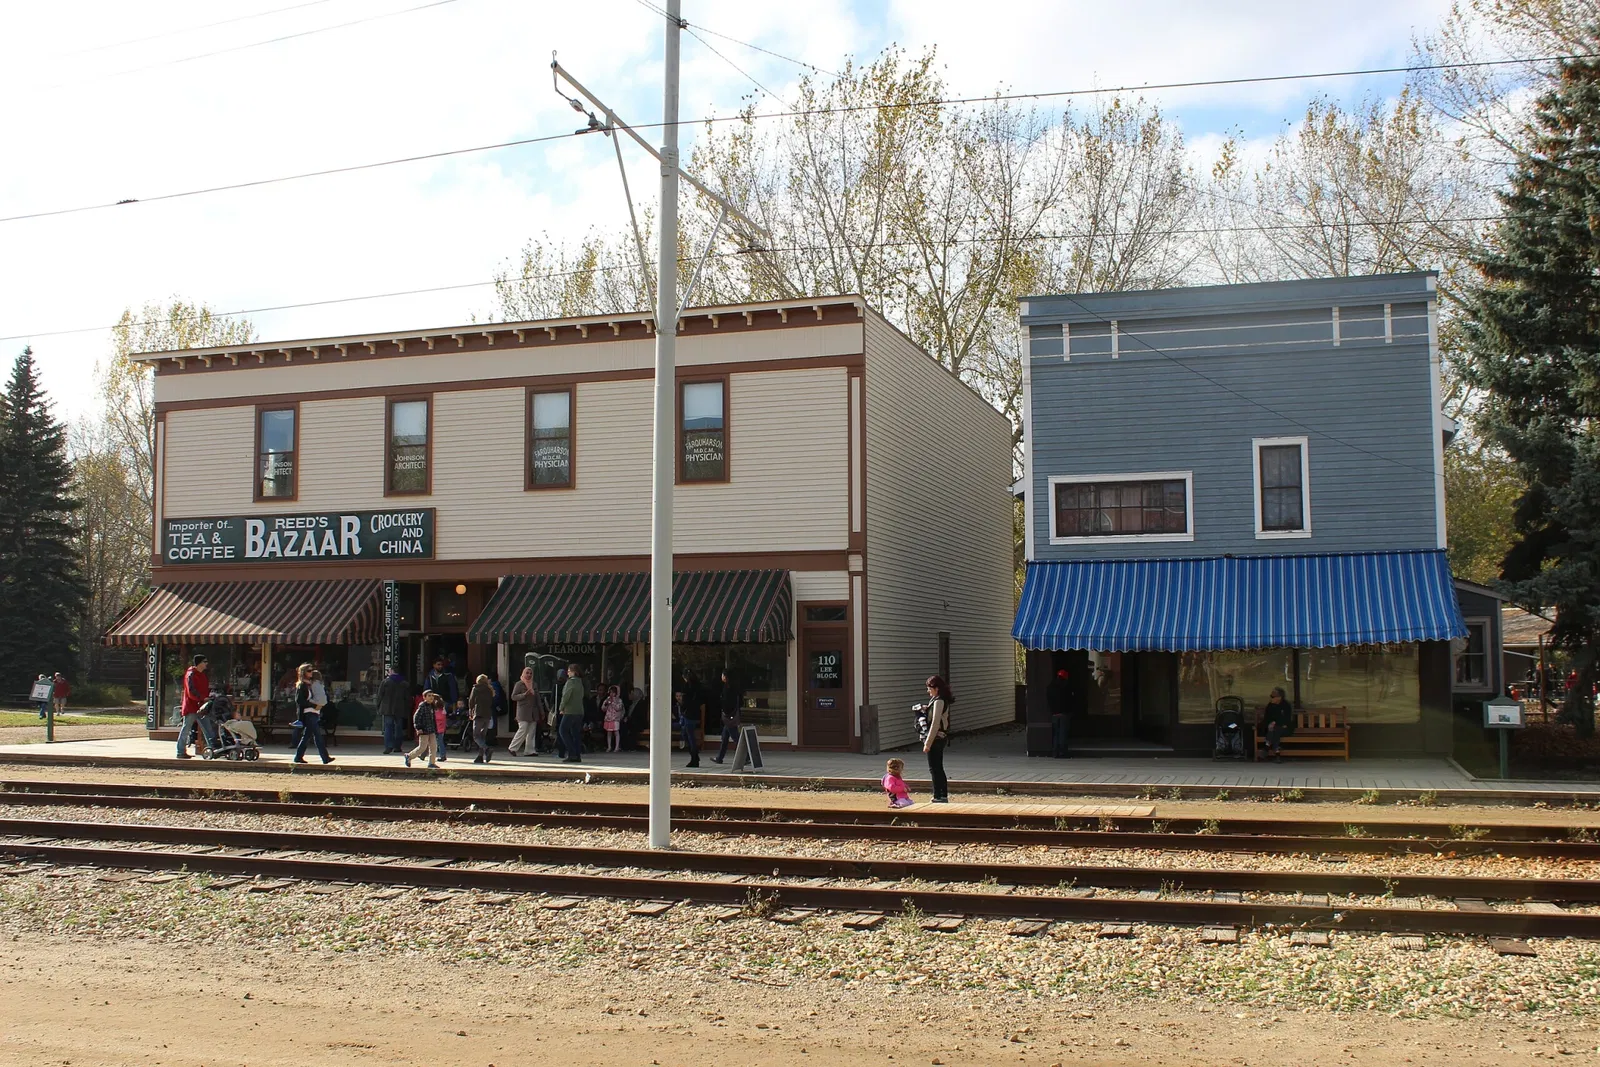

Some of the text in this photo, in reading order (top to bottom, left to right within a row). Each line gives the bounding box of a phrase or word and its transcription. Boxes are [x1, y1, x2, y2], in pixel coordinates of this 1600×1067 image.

[394, 454, 425, 462] JOHNSON
[685, 452, 724, 462] PHYSICIAN
[534, 460, 569, 469] PHYSICIAN
[168, 521, 214, 532] Importer
[275, 516, 329, 530] REED'S
[370, 512, 424, 534] CROCKERY
[168, 532, 222, 545] TEA &
[244, 515, 362, 558] BAZAAR
[401, 528, 424, 538] AND
[168, 545, 235, 560] COFFEE
[379, 540, 424, 554] CHINA
[547, 644, 596, 654] TEAROOM
[819, 655, 836, 665] 110
[148, 647, 156, 723] NOVELTIES
